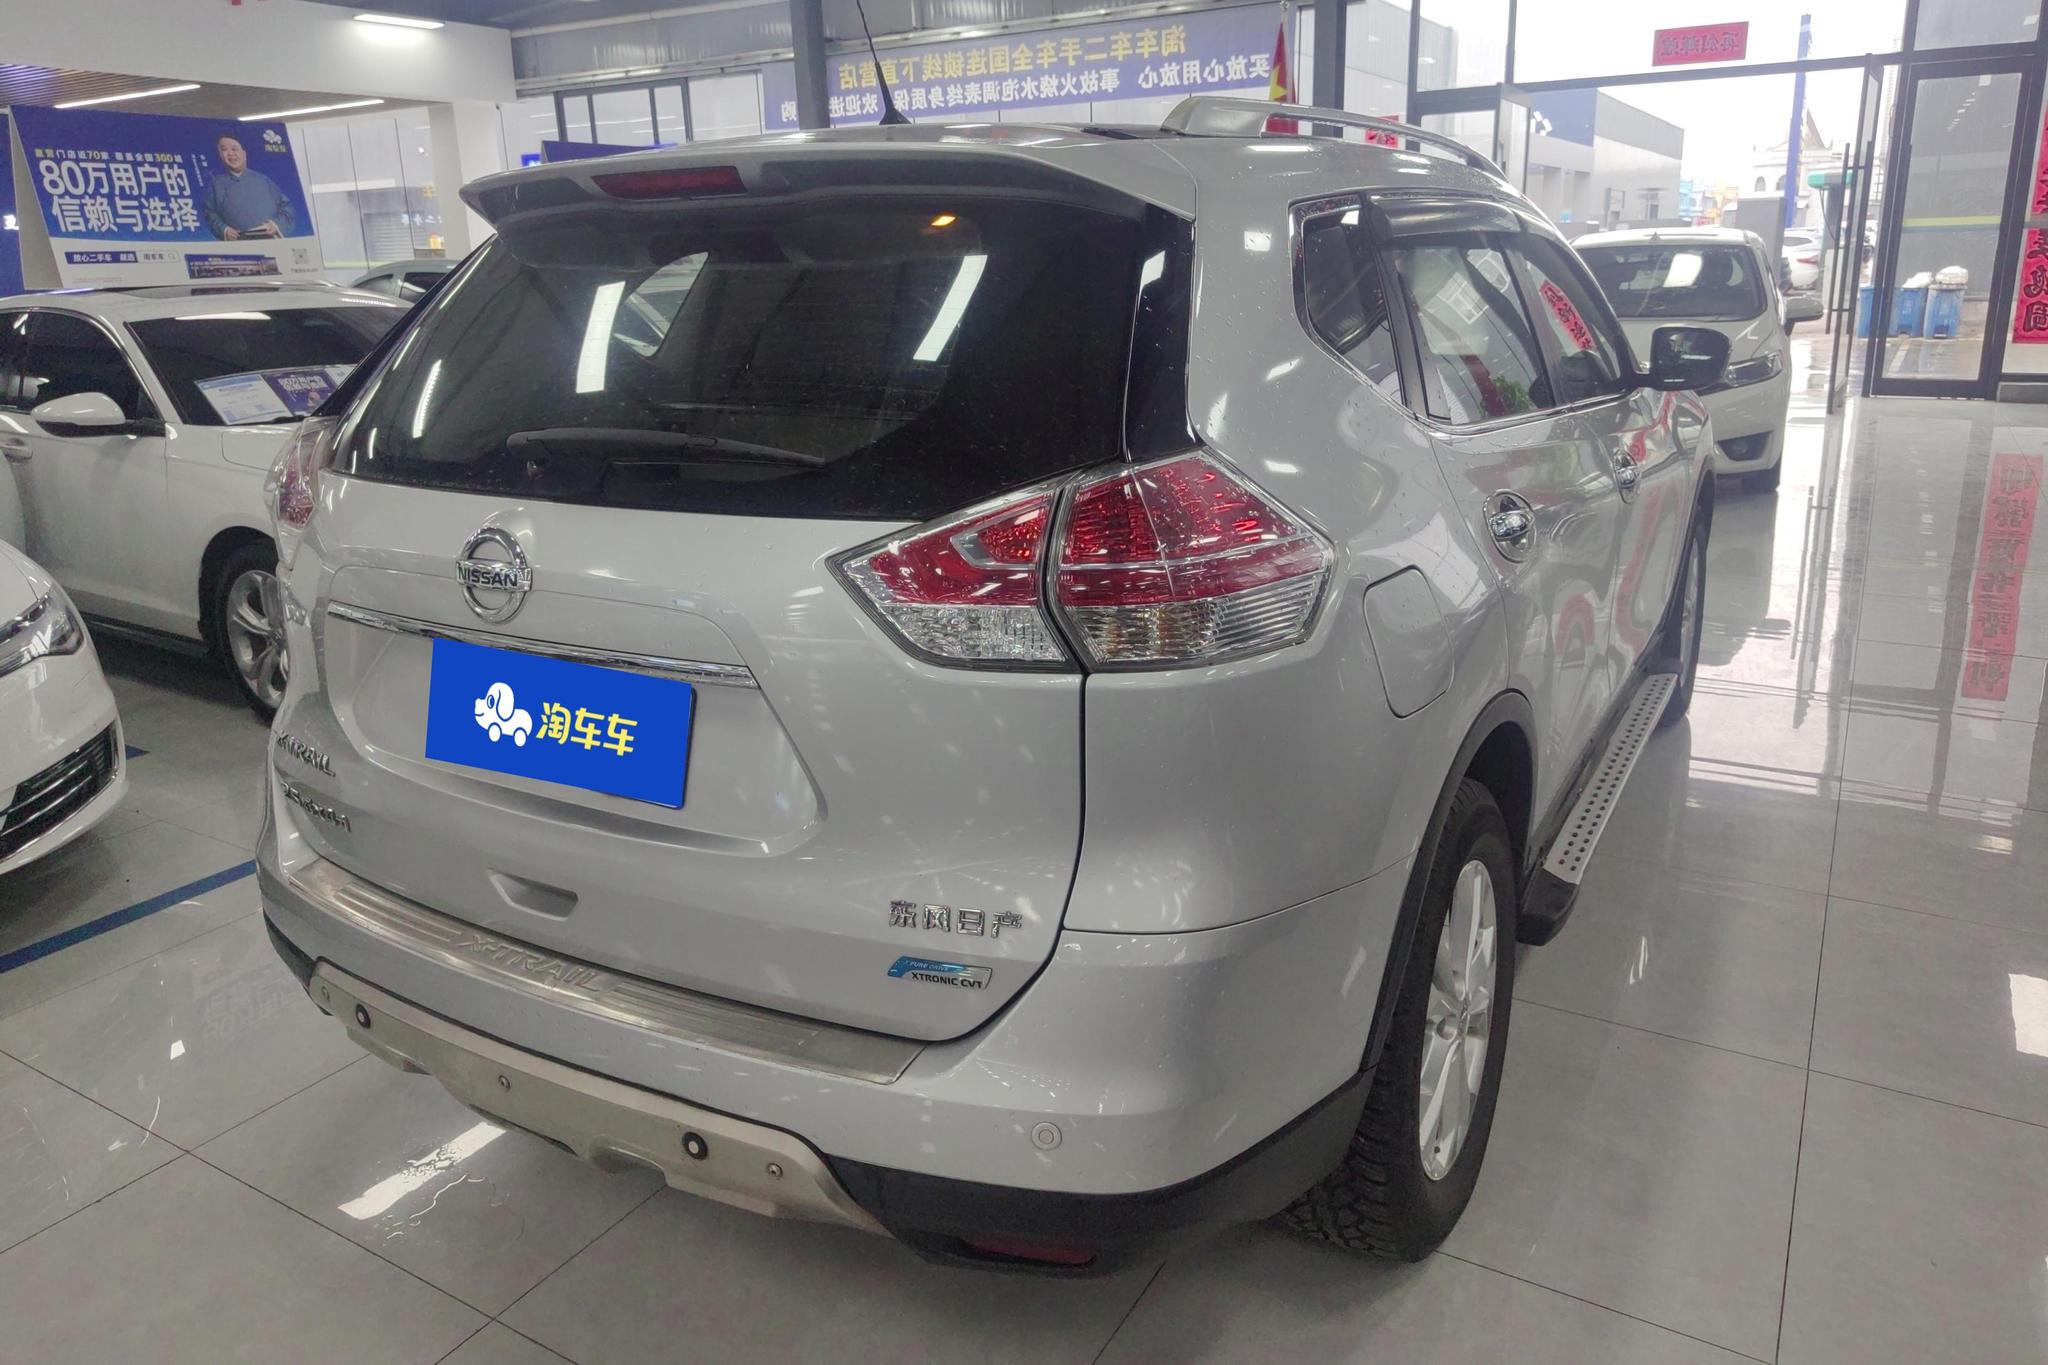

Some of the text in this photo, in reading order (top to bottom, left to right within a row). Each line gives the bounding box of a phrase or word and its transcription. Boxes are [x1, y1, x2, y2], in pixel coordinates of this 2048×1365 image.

[39, 160, 191, 196] 80万用户的
[52, 195, 200, 233] 信赖与选择
[457, 566, 518, 587] NISSAN
[889, 900, 1023, 939] 东风日产
[911, 972, 982, 989] XTRONIC CVT
